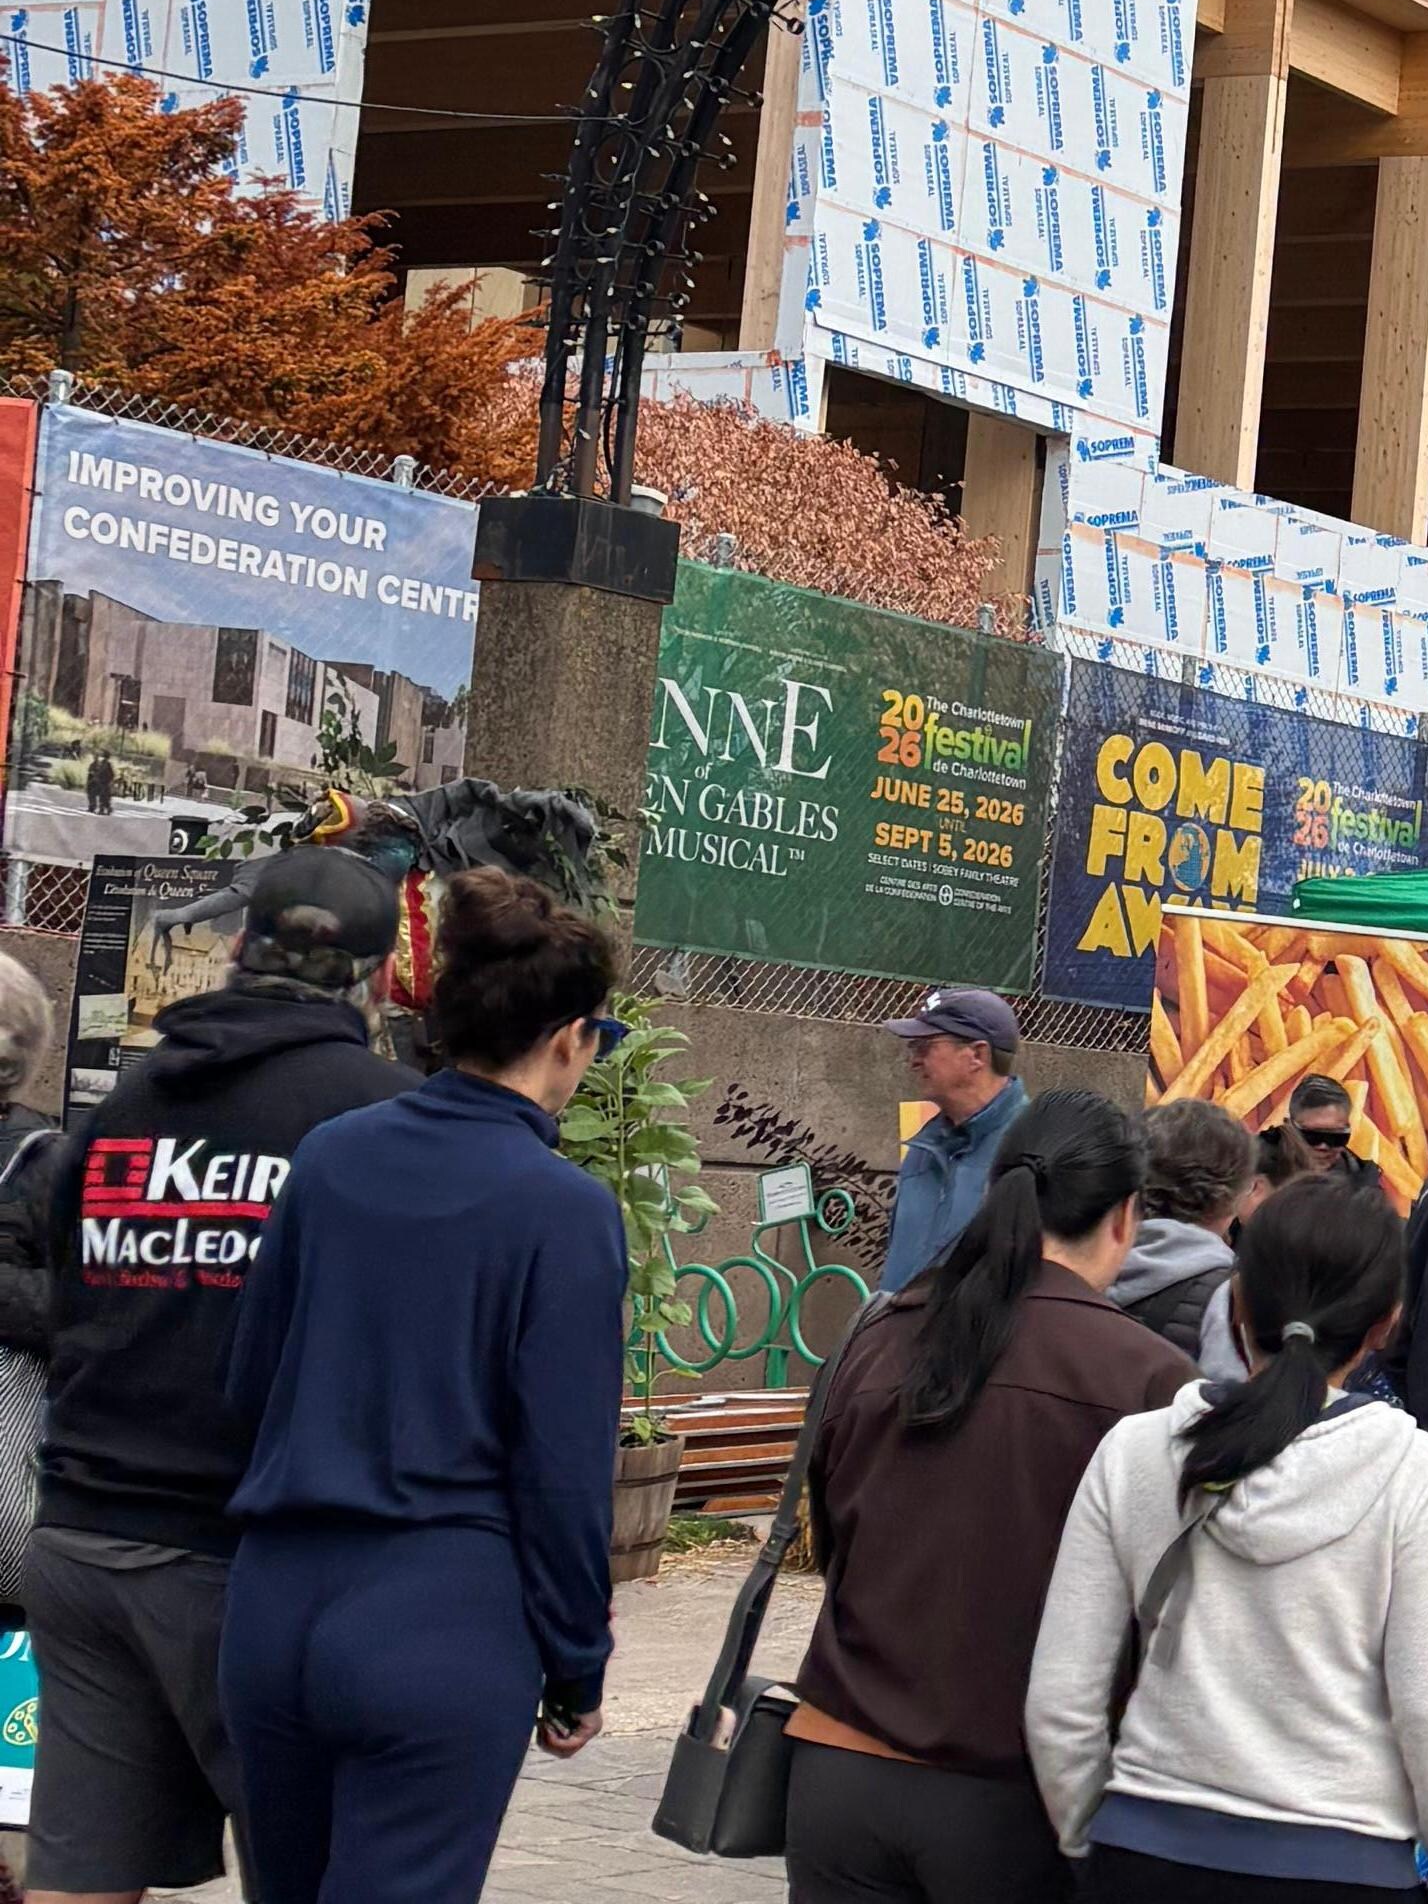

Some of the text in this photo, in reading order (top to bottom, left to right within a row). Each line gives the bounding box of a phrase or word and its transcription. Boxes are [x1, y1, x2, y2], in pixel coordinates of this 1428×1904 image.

[196, 0, 213, 78] SOPREMA
[982, 18, 997, 104] SOPREMA
[1173, 7, 1185, 87] SOPREMA
[868, 96, 884, 184] SOPREMA
[1050, 66, 1064, 150] SOPREMA
[1092, 66, 1105, 148] SOPREMA
[287, 105, 305, 189] SOPREMA
[983, 142, 997, 227] SOPREMA
[1154, 112, 1166, 192] SOPREMA
[939, 144, 954, 231] SOPREMA
[1092, 185, 1106, 268] SOPREMA
[1050, 188, 1063, 272] SOPREMA
[872, 244, 887, 330] SOPREMA
[918, 239, 932, 325] SOPREMA
[963, 256, 978, 340] SOPREMA
[1154, 230, 1166, 310] SOPREMA
[1030, 299, 1044, 383] SOPREMA
[1073, 296, 1086, 377] SOPREMA
[1136, 337, 1148, 418] SOPREMA
[67, 450, 387, 552] IMPROVING YOUR
[63, 506, 368, 599] CONFEDERATION
[1064, 534, 1076, 614] SOPREMA
[1166, 563, 1178, 640] SOPREMA
[1216, 575, 1227, 652] SOPREMA
[1308, 602, 1319, 676] SOPREMA
[1348, 611, 1358, 684] SOPREMA
[878, 727, 922, 768] 26
[881, 689, 924, 730] 20
[924, 712, 1032, 771] festival
[927, 696, 1025, 729] The Charlottetown
[694, 762, 713, 780] of
[870, 776, 1025, 826] JUNE 25, 2026
[933, 760, 1027, 790] de Charlottetown
[1097, 734, 1264, 832] COME
[1297, 777, 1331, 812] 20
[1333, 781, 1350, 797] The
[699, 784, 839, 842] GABLES
[875, 822, 1013, 868] SEPT 5, 2026
[1293, 810, 1328, 848] 26
[1331, 797, 1423, 849] festival
[1337, 841, 1350, 854] de
[144, 864, 179, 881] Queen
[181, 865, 218, 884] Square
[159, 882, 193, 899] Queen
[868, 853, 900, 866] SELECT
[1086, 804, 1262, 903] FROM
[147, 1138, 291, 1202] KEIR
